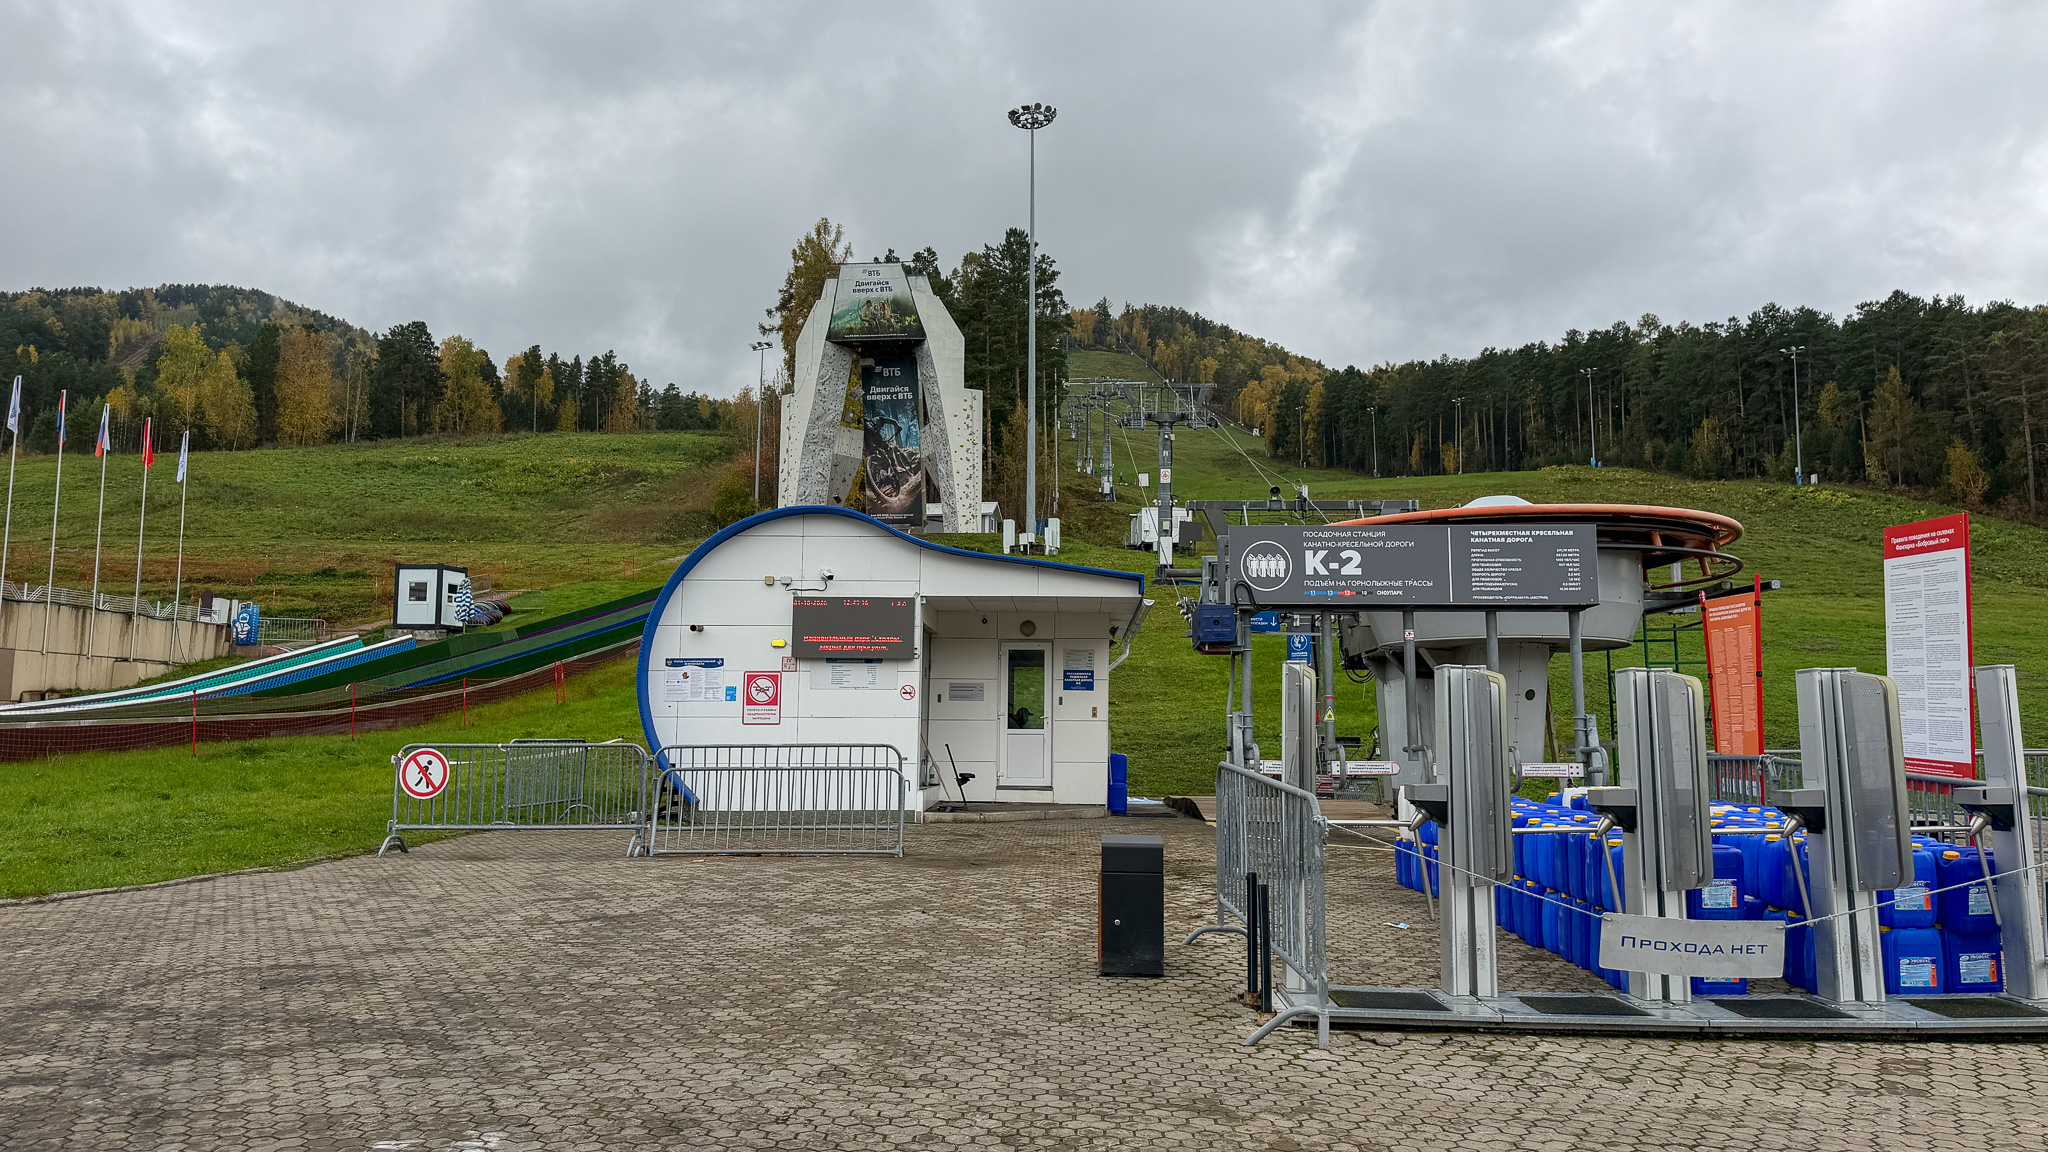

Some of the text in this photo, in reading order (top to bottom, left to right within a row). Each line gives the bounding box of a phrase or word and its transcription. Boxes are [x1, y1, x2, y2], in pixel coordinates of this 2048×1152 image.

[867, 269, 881, 277] ВТБ
[855, 279, 890, 288] Двигайся
[882, 367, 901, 377] ВТБ
[869, 385, 909, 394] Двигайся
[866, 394, 892, 402] вверх
[897, 392, 914, 400] ВТБ
[1890, 536, 1908, 545] Правила
[1908, 532, 1930, 542] поведения
[1936, 528, 1955, 536] склонах
[1620, 935, 1768, 956] ПРОХОДА НЕТ
